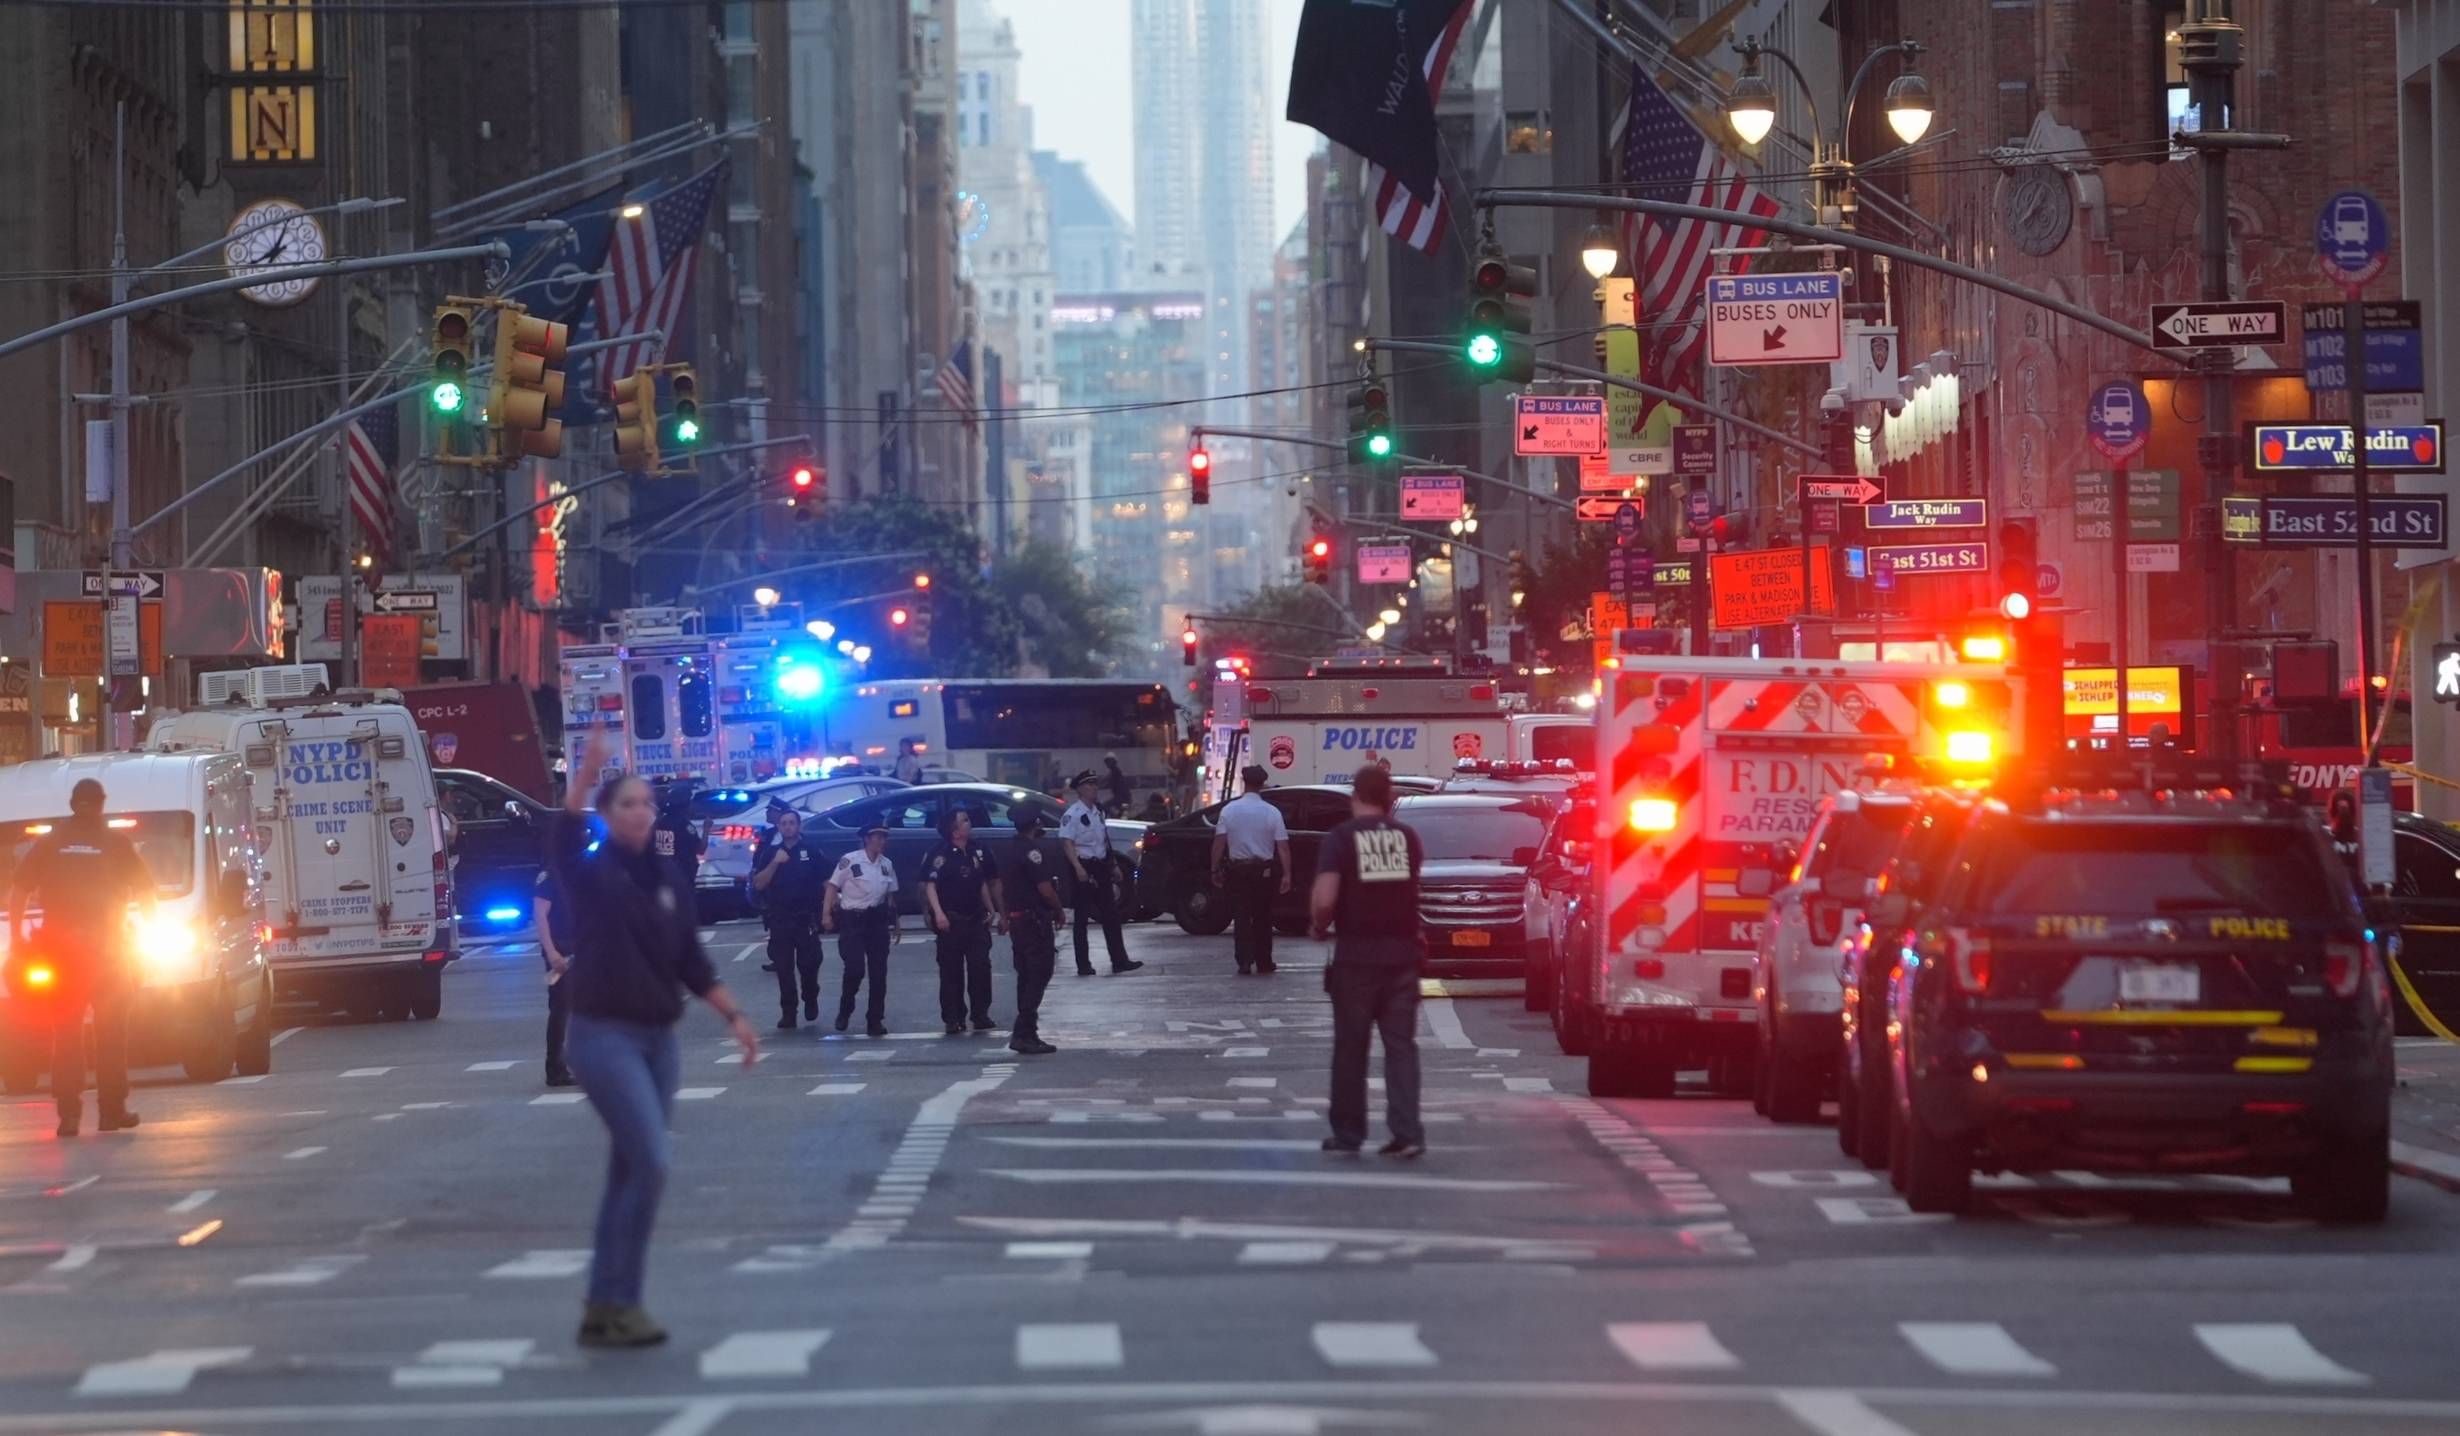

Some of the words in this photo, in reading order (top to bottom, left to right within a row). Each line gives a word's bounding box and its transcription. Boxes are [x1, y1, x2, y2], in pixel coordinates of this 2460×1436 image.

[1743, 282, 1777, 296] BUS
[1783, 280, 1830, 295] LANE
[1716, 304, 1777, 321] BUSES
[1787, 302, 1832, 319] ONLY
[2304, 307, 2345, 329] M101
[2173, 317, 2209, 334] ONE
[2228, 315, 2267, 332] WAY
[2305, 335, 2345, 357] M102
[2307, 364, 2346, 386] M103
[1539, 402, 1562, 411] BUS
[1566, 401, 1598, 411] LANE
[1544, 416, 1569, 425] BUSES
[1570, 415, 1595, 425] ONLY
[1685, 429, 1708, 437] NYPD
[2286, 430, 2335, 451] Lew
[2341, 429, 2410, 450] Rudin
[1543, 439, 1567, 448] RIGHT
[1569, 439, 1596, 448] TURNS
[1629, 453, 1663, 463] CBRE
[1682, 452, 1714, 462] Security
[2333, 451, 2355, 464] Wa
[1682, 461, 1714, 470] Camera
[1808, 485, 1832, 497] ONE
[1843, 484, 1869, 496] WAY
[1890, 504, 1920, 518] Jack
[1923, 503, 1961, 516] Rudin
[2076, 497, 2110, 515] SIM22
[1915, 515, 1937, 526] Way
[2267, 509, 2326, 533] East
[2405, 510, 2433, 534] St
[2076, 521, 2112, 539] SIM26
[1735, 559, 1741, 571] E
[1743, 557, 1755, 569] 47
[1759, 556, 1768, 568] ST
[1880, 552, 1915, 568] ast
[1920, 551, 1954, 568] 51st
[1958, 549, 1978, 566] St
[1670, 568, 1691, 581] 50t
[1751, 572, 1791, 587] BETWEEN
[124, 579, 148, 589] WAY
[410, 596, 430, 605] WAY
[1725, 593, 1746, 604] PARK
[1760, 588, 1800, 602] MADISON
[1605, 602, 1627, 613] EAS
[1600, 618, 1616, 629] 47
[418, 706, 443, 718] CPC
[446, 703, 468, 716] L-2
[1323, 727, 1417, 750] POLICE
[288, 741, 362, 764] NYPD
[635, 744, 672, 761] TRUCK
[681, 742, 714, 758] EIGHT
[274, 760, 380, 786] POLICE
[636, 762, 714, 775] EMERGENCY
[287, 802, 328, 817] CRIME
[332, 799, 373, 814] SCENE
[315, 820, 346, 834] UNIT
[1355, 829, 1408, 853] NYPD
[1360, 853, 1410, 872] POLICE
[331, 895, 372, 906] STOPPERS
[1730, 920, 1765, 942] KE
[2036, 915, 2107, 937] STATE
[2209, 916, 2290, 940] POLICE
